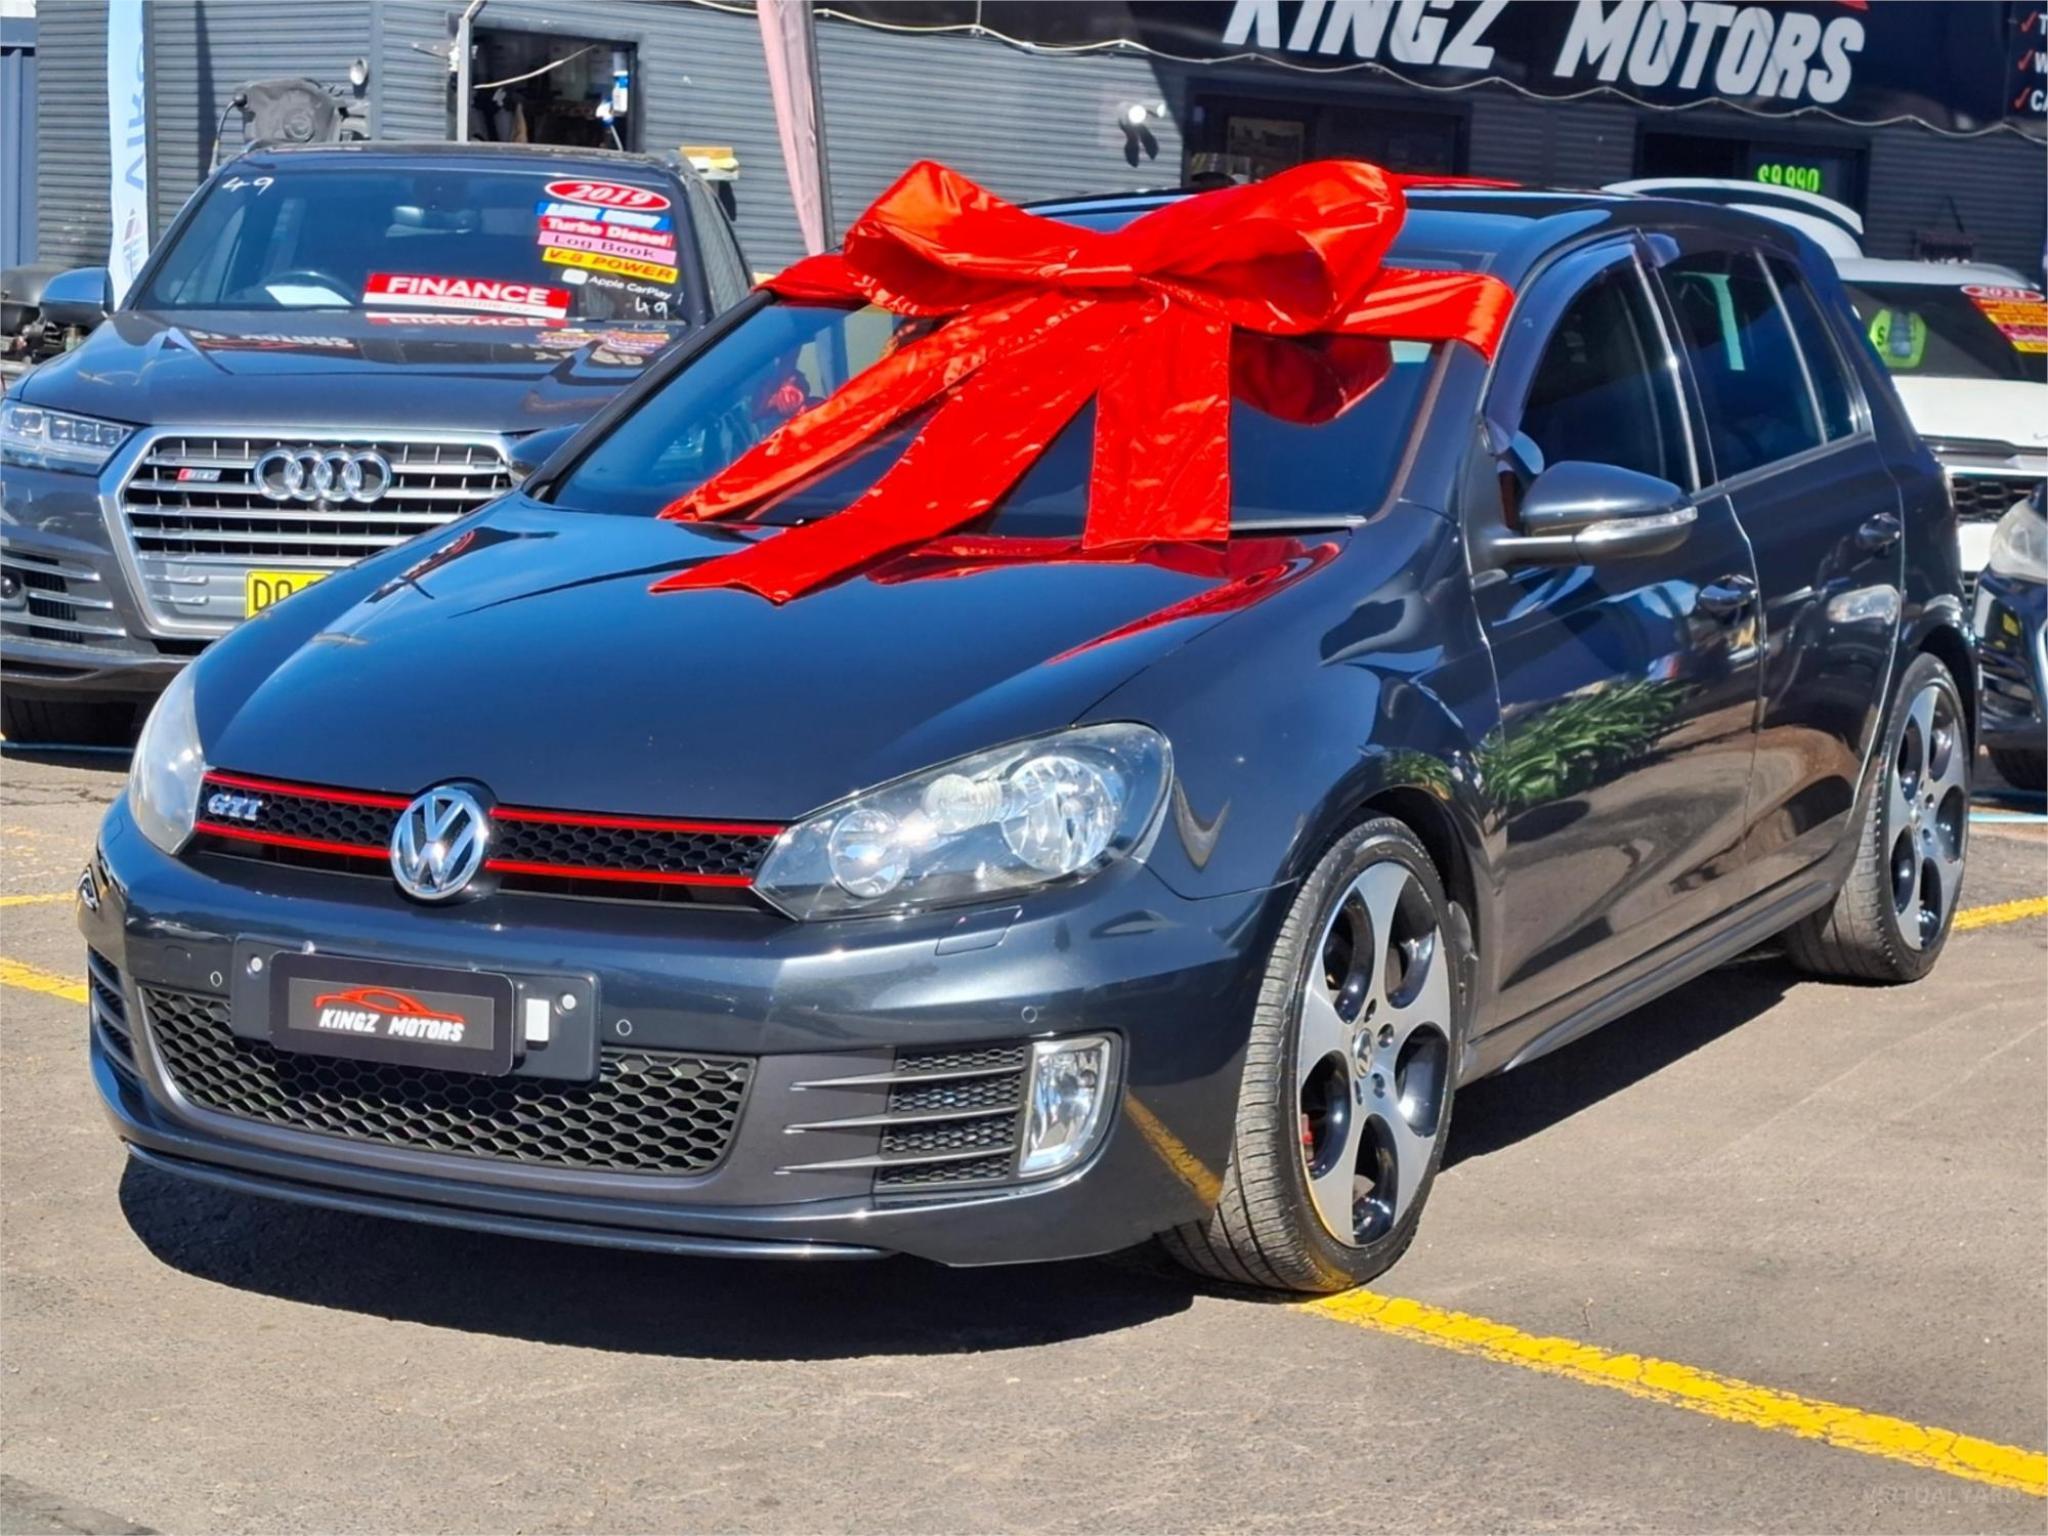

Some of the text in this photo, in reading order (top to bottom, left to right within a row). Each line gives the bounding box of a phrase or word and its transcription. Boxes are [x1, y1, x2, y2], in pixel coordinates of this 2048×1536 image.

[1553, 1, 1865, 104] MOTORS
[572, 184, 653, 207] 2019
[547, 216, 603, 236] Turbo
[554, 235, 655, 258] Log Book
[592, 256, 673, 280] POWER
[386, 276, 551, 305] FINANCE
[589, 275, 673, 301] Apple CarPlay
[208, 793, 263, 822] GTI
[319, 1008, 466, 1043] KINGZ MOTORS
